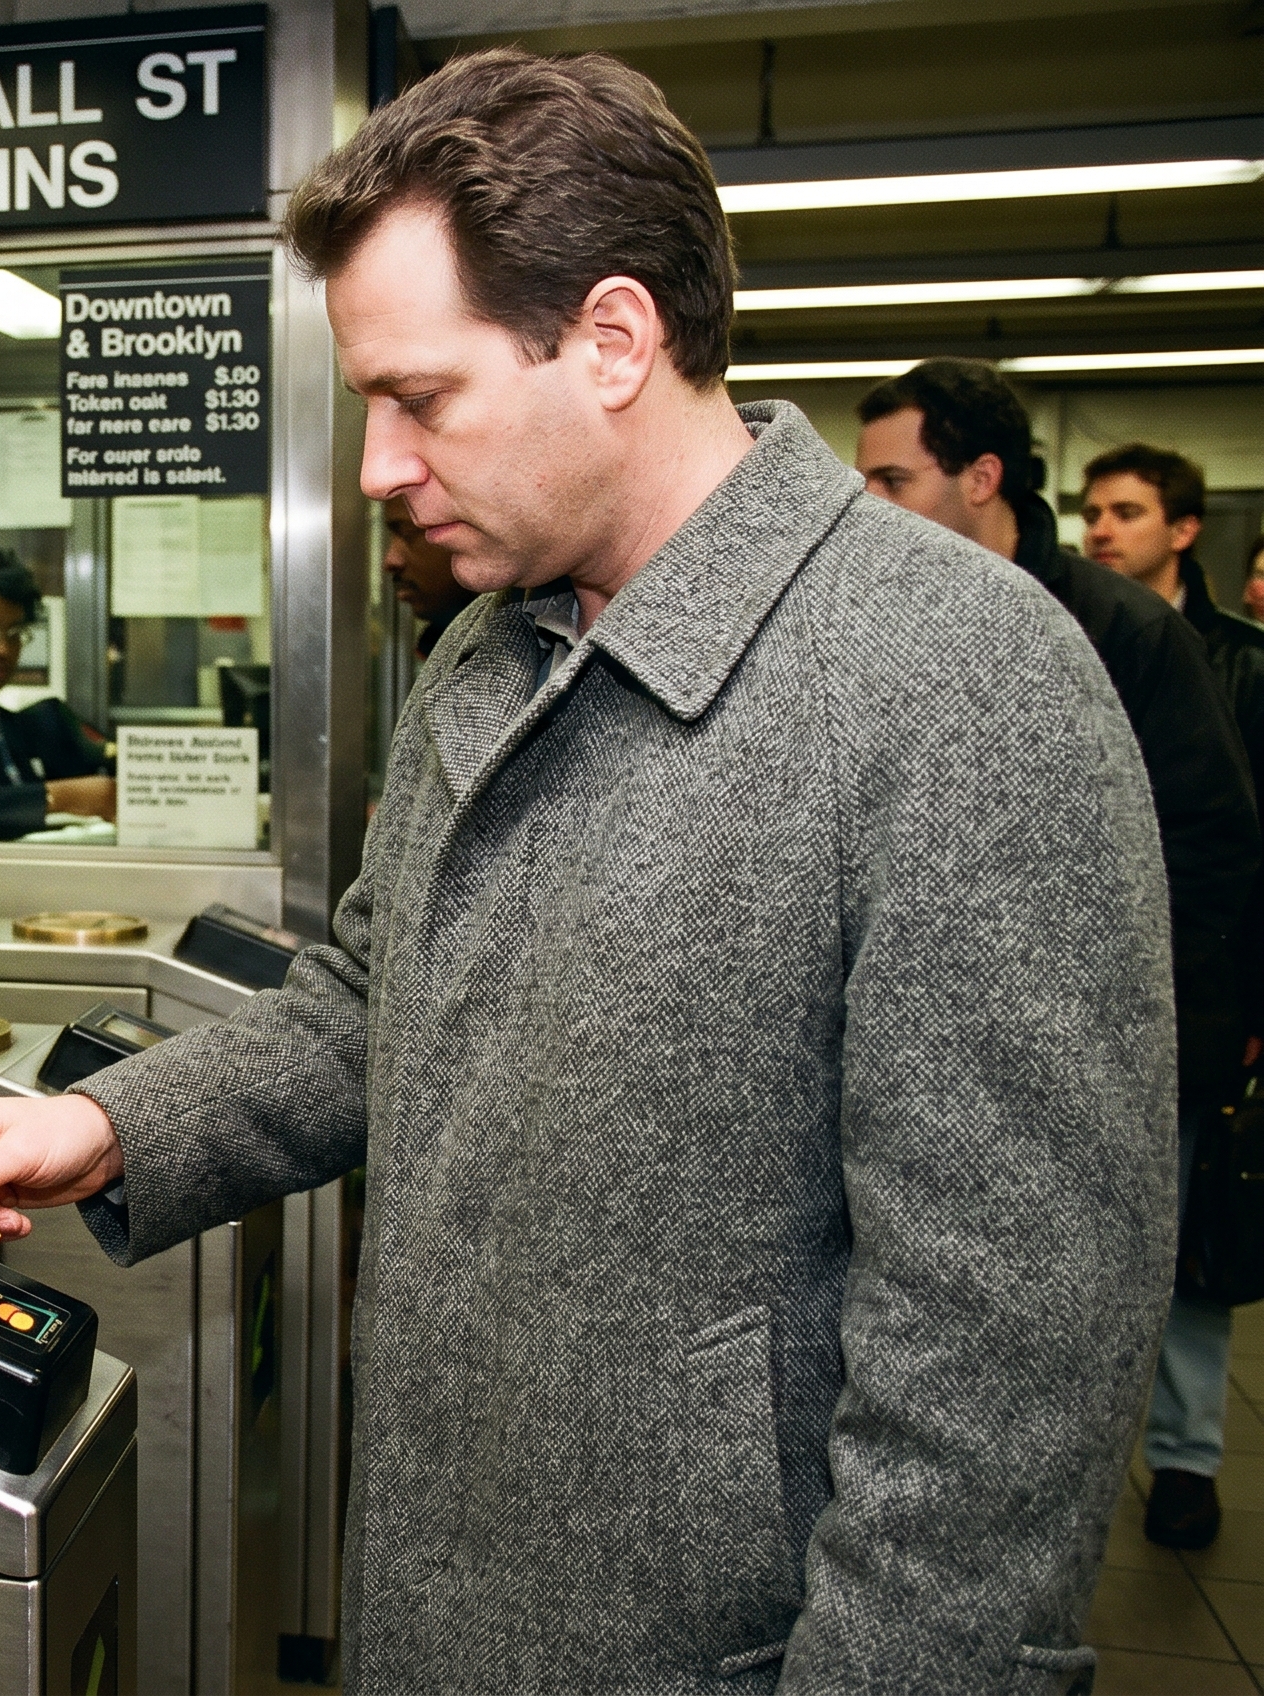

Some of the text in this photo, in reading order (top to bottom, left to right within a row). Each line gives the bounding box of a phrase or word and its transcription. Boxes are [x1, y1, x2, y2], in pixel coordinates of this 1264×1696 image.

[136, 49, 238, 121] ST
[65, 291, 232, 323] Downtown
[66, 324, 243, 360] & Brooklyn
[66, 393, 124, 413] Token
[204, 388, 260, 410] $1.30
[205, 411, 260, 433] $1.30
[66, 447, 98, 466] For
